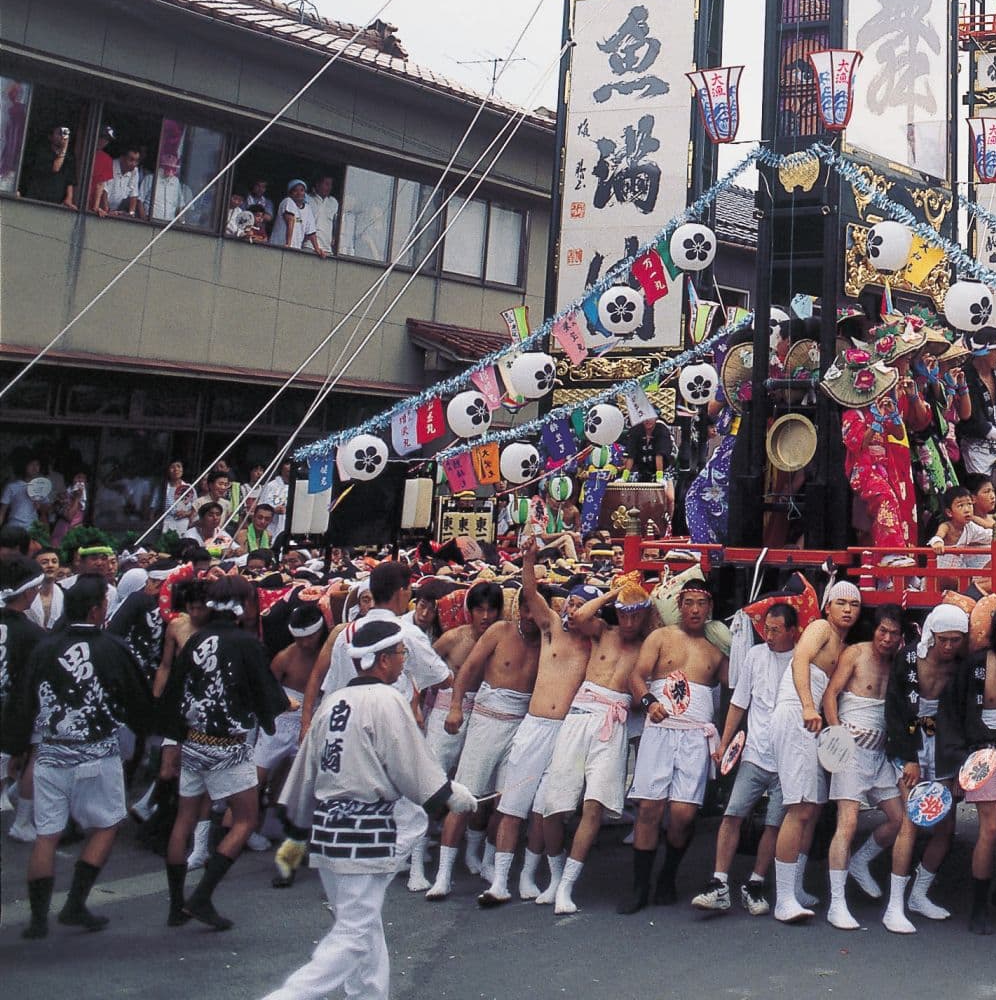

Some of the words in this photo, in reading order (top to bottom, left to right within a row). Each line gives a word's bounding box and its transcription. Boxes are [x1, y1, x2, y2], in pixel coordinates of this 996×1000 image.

[711, 72, 726, 98] 大漁
[836, 58, 850, 85] 大漁
[58, 641, 94, 684] 男
